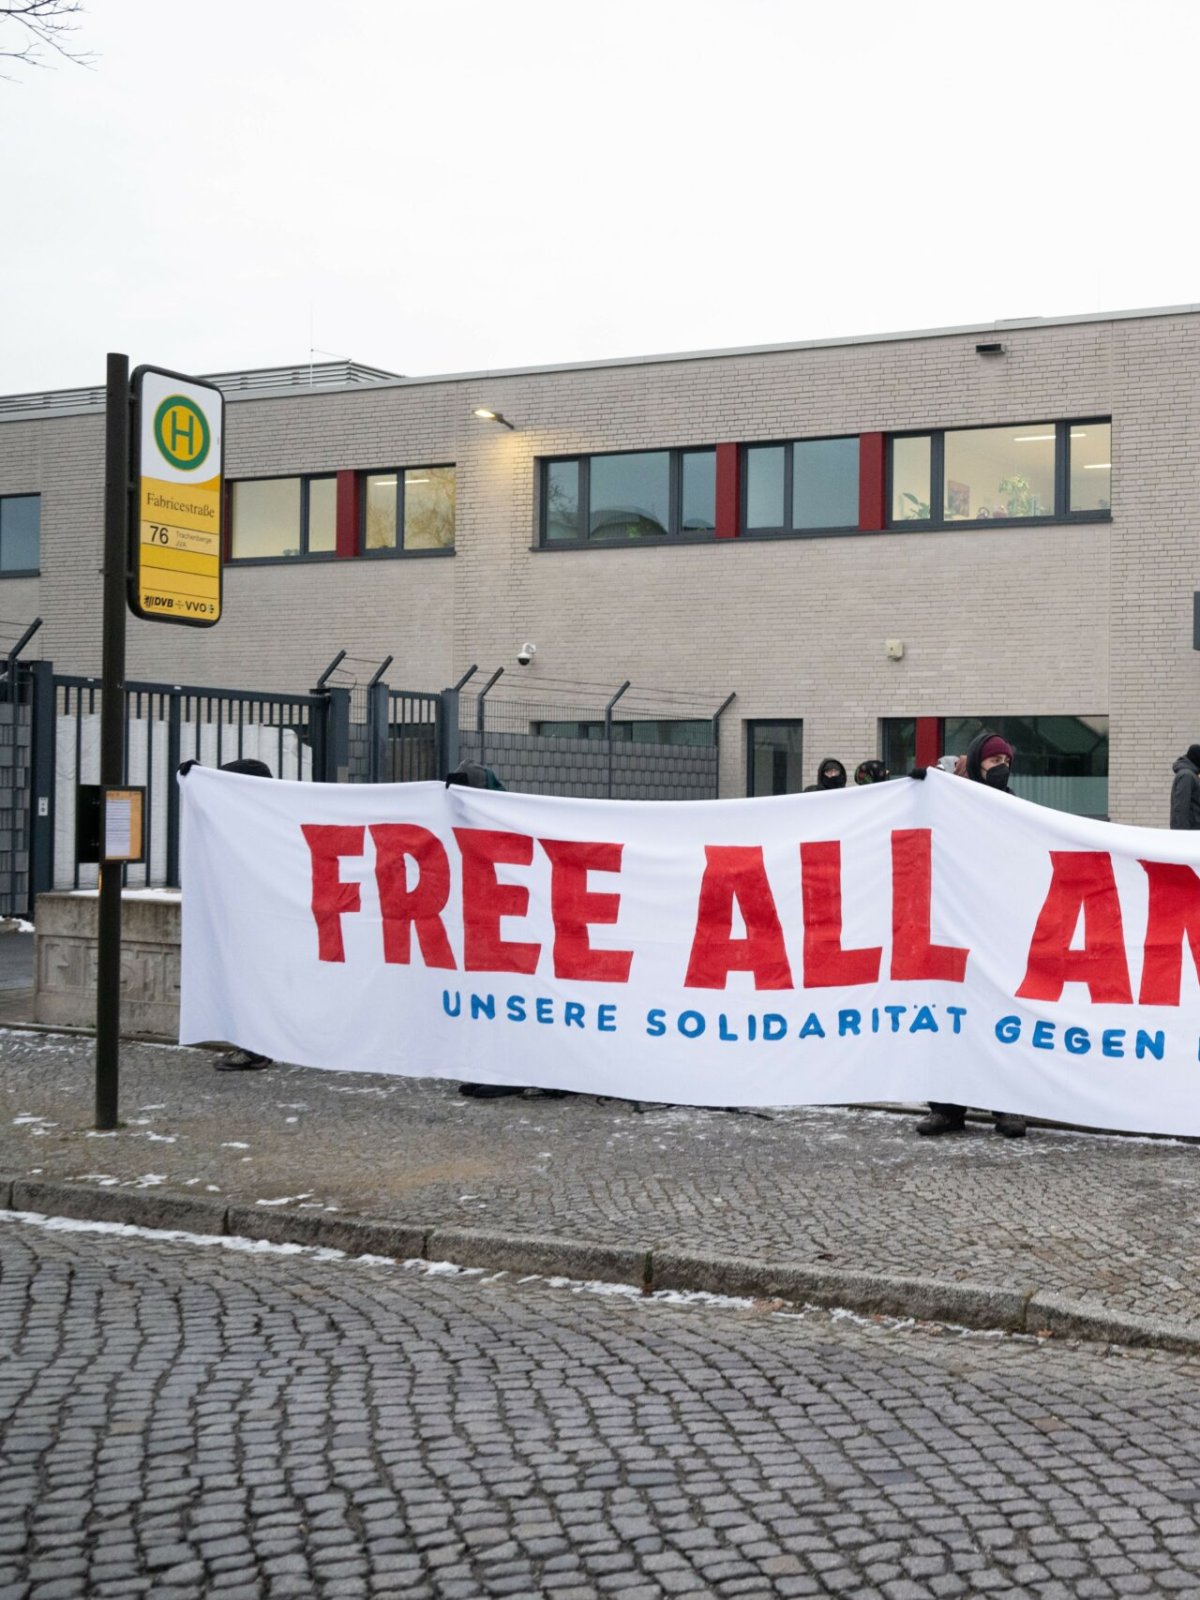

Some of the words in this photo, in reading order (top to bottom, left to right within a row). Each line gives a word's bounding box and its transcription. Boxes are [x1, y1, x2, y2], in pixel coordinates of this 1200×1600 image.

[170, 410, 194, 456] H
[146, 491, 215, 519] Fabricestraße
[150, 525, 169, 545] 76
[154, 596, 174, 608] DVB
[185, 601, 207, 613] VVO
[301, 823, 633, 983] FREE
[684, 828, 970, 991] ALL
[441, 989, 619, 1033] UNSERE
[645, 1003, 968, 1045] SOLIDARITÄT
[993, 1014, 1166, 1062] GEGEN
